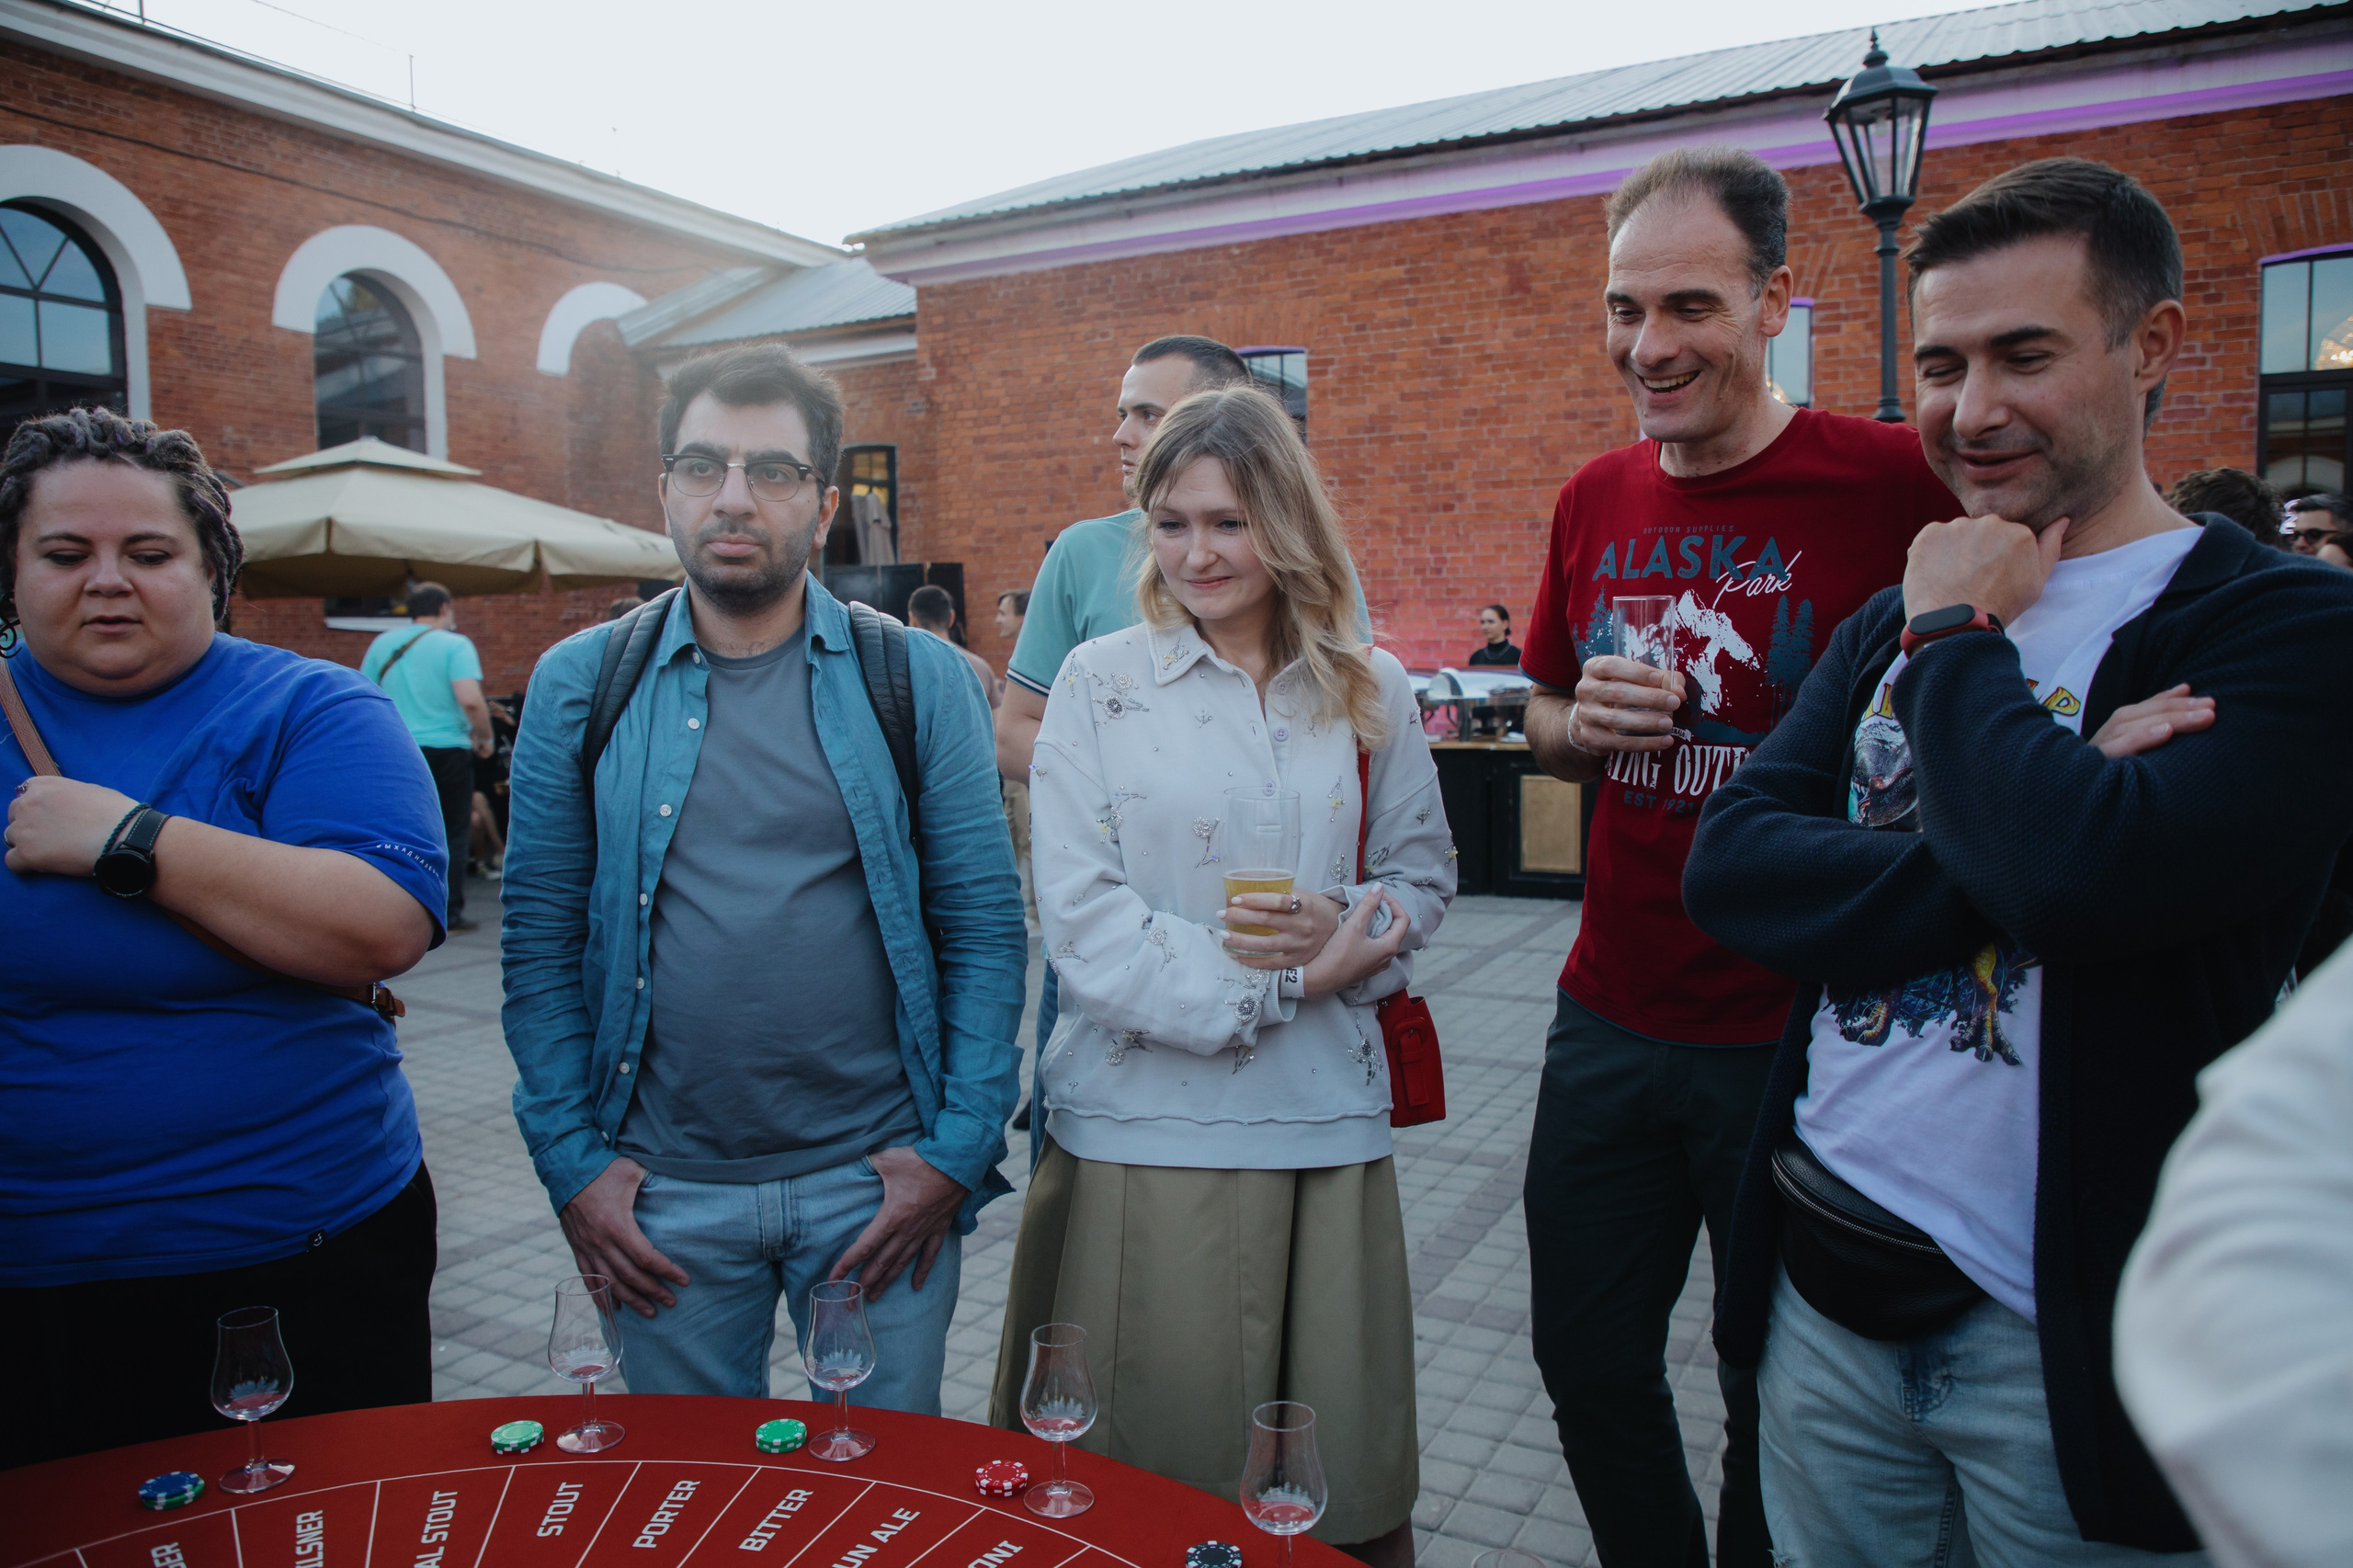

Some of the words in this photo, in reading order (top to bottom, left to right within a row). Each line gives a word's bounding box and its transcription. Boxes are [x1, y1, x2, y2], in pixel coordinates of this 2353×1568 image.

[1643, 526, 1681, 534] OUTDOOR
[1686, 525, 1735, 533] SUPPLIES
[1592, 535, 1789, 581] ALASKA
[1713, 550, 1802, 609] Park
[1605, 750, 1662, 790] ING
[1623, 790, 1657, 810] EST
[420, 1490, 459, 1544] STOUT
[536, 1482, 584, 1538] STOUT
[631, 1480, 701, 1549] PORTER
[738, 1489, 814, 1552] BITTER
[870, 1507, 921, 1544] ALE
